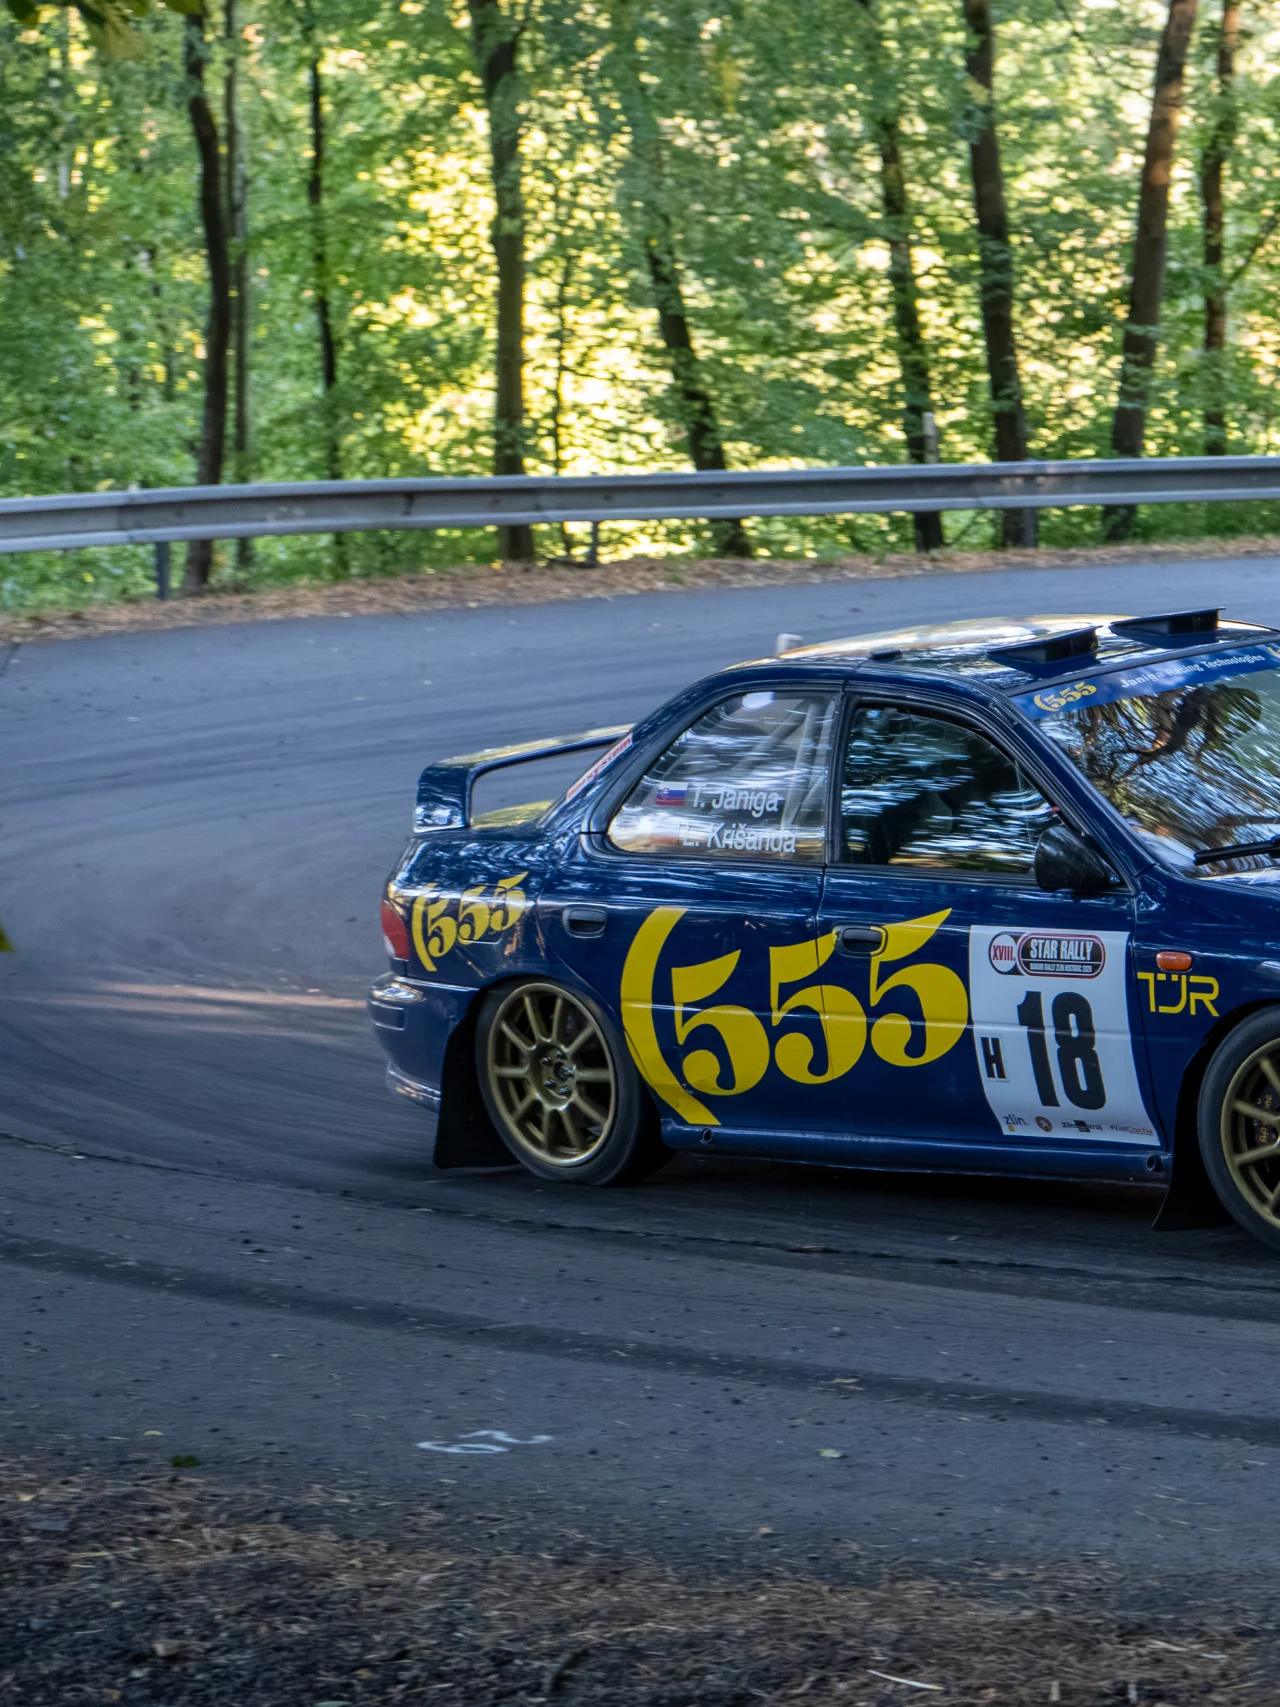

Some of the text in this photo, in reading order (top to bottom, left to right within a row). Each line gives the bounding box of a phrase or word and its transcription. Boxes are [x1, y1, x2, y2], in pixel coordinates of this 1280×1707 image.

[1121, 670, 1165, 690] Janiga
[1166, 661, 1204, 679] Racing
[1201, 652, 1266, 671] Technologies
[711, 784, 779, 818] Janiga
[1030, 938, 1094, 961] STAR RALLY
[980, 1036, 1008, 1080] H
[1016, 990, 1107, 1111] 18
